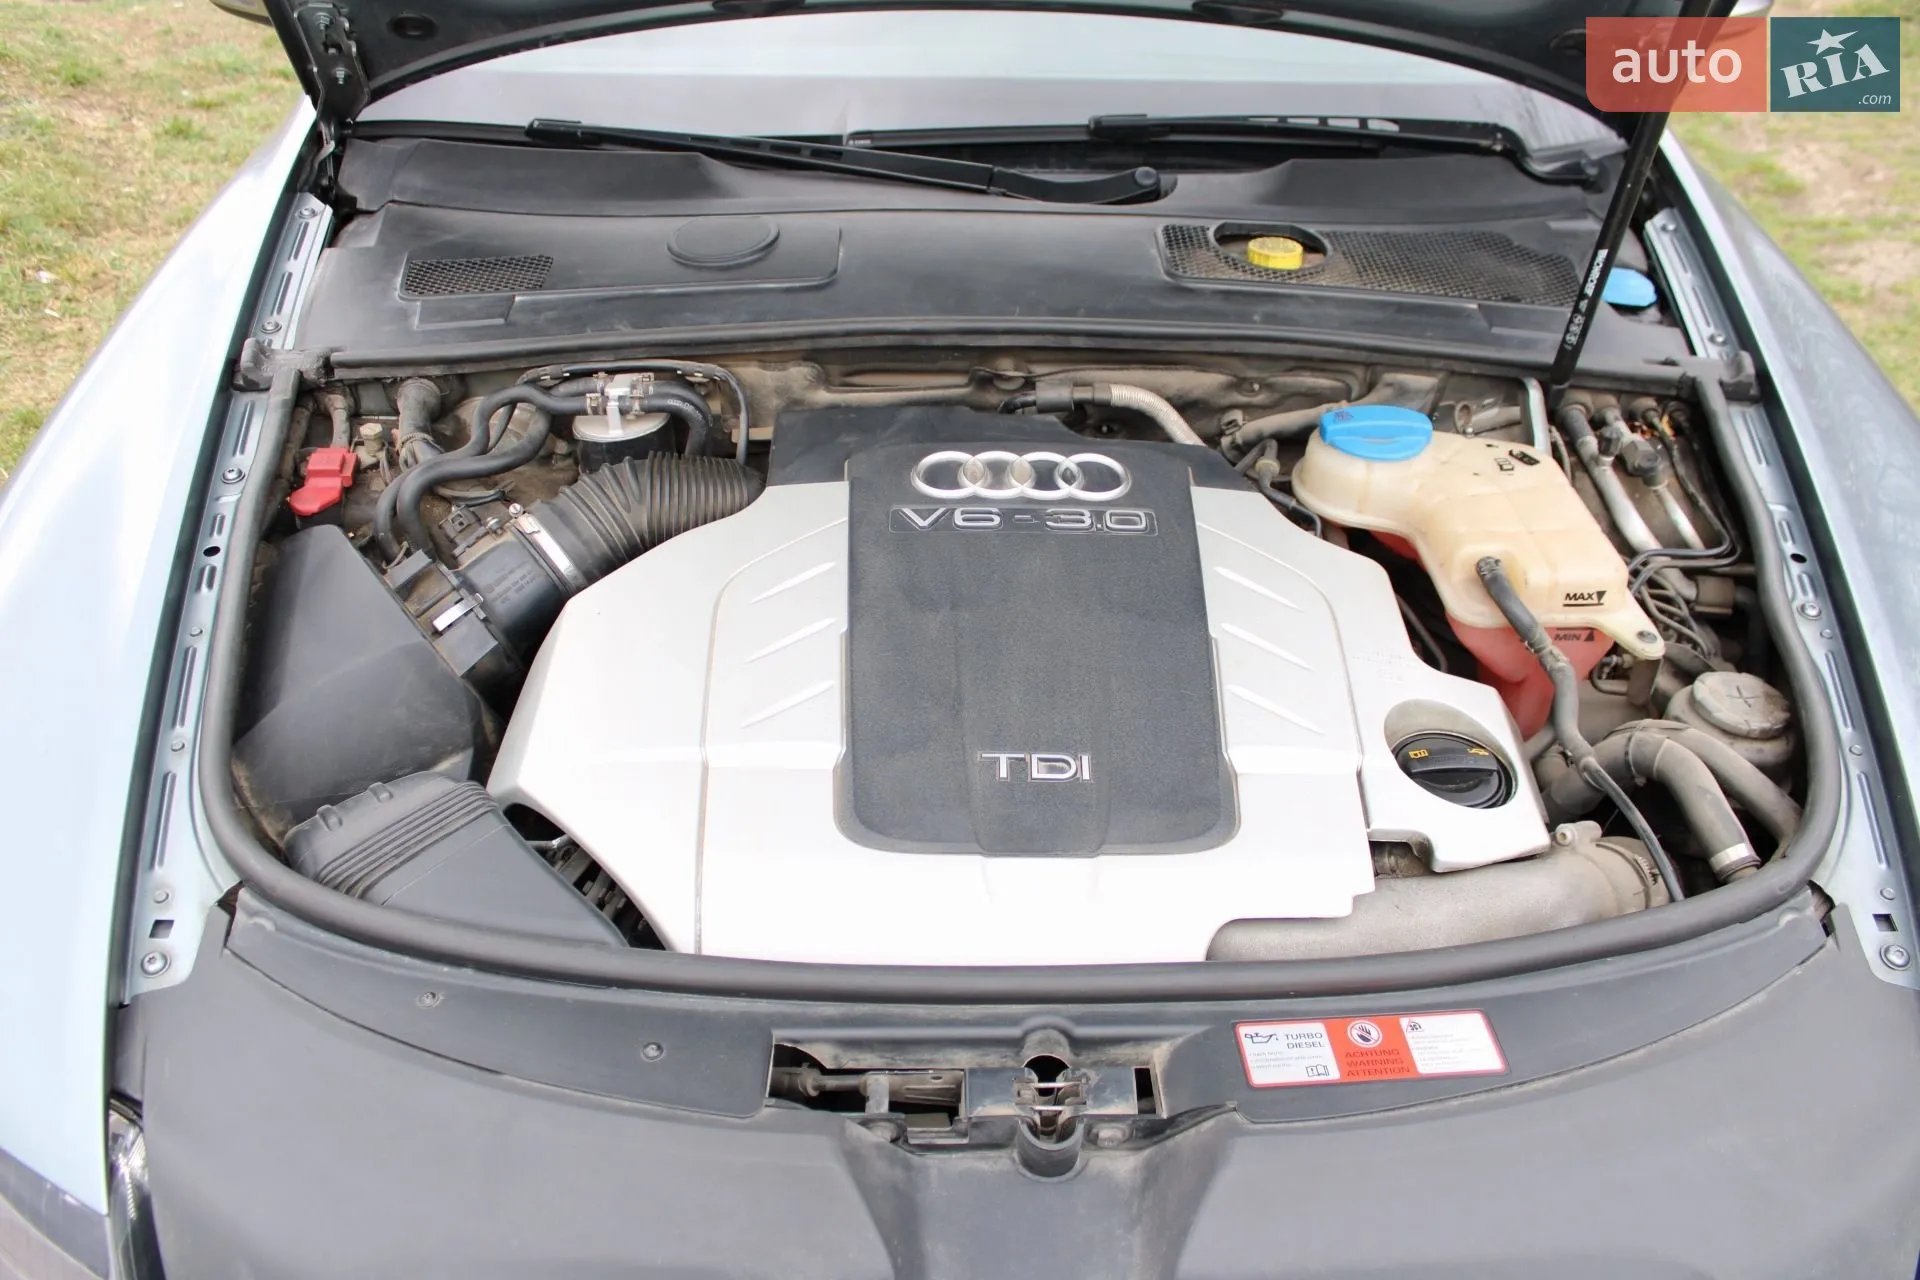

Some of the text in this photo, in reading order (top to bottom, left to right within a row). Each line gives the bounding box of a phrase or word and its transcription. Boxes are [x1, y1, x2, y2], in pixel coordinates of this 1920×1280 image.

[1565, 592, 1595, 601] MAX
[1554, 632, 1582, 641] MIN
[979, 752, 1091, 780] TDI
[1284, 1032, 1323, 1041] TURBO
[1286, 1041, 1325, 1050] DIESEL
[1345, 1048, 1400, 1059] ACHTUNG
[1346, 1057, 1404, 1067] WARNING
[1347, 1065, 1410, 1077] ATTENTION
